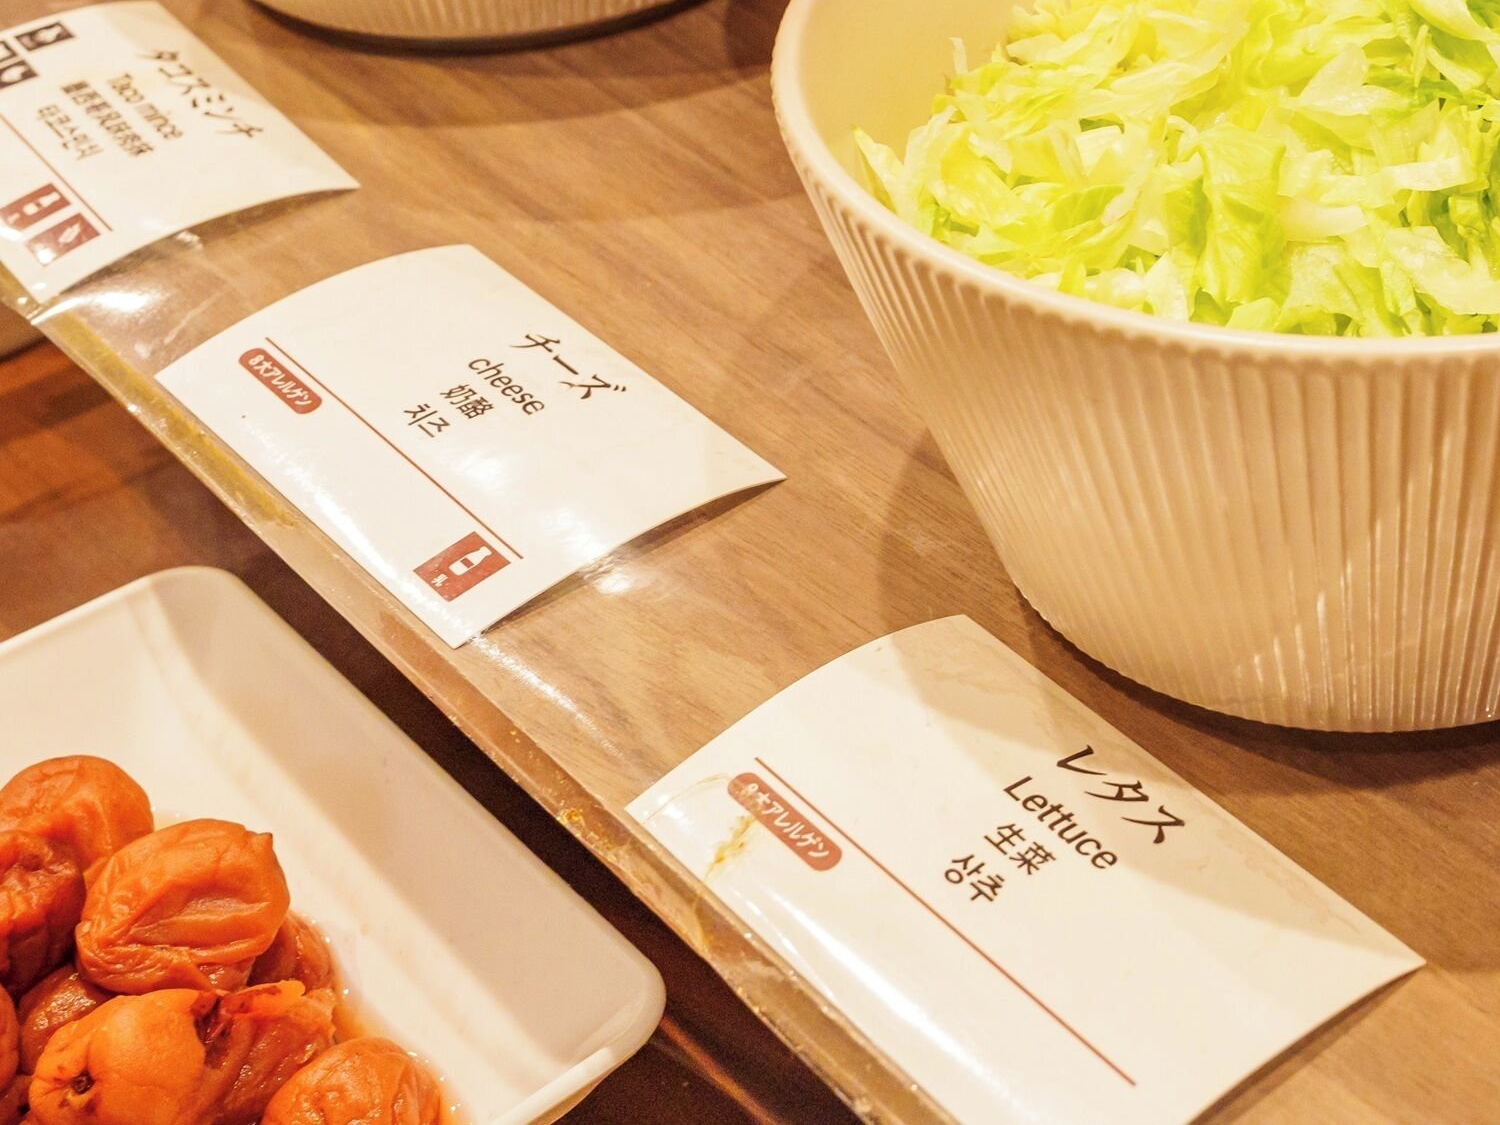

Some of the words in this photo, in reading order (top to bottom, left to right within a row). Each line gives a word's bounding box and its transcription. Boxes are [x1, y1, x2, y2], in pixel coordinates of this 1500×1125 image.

[248, 353, 314, 407] 8大アレルゲン
[468, 357, 545, 416] cheese
[510, 332, 627, 400] チーズ
[404, 403, 451, 438] 치즈
[440, 384, 494, 419] 奶酪
[1056, 744, 1186, 844] レタス
[984, 823, 1057, 876] 生菜
[1003, 776, 1118, 870] Lettuce
[944, 853, 1006, 903] 상추
